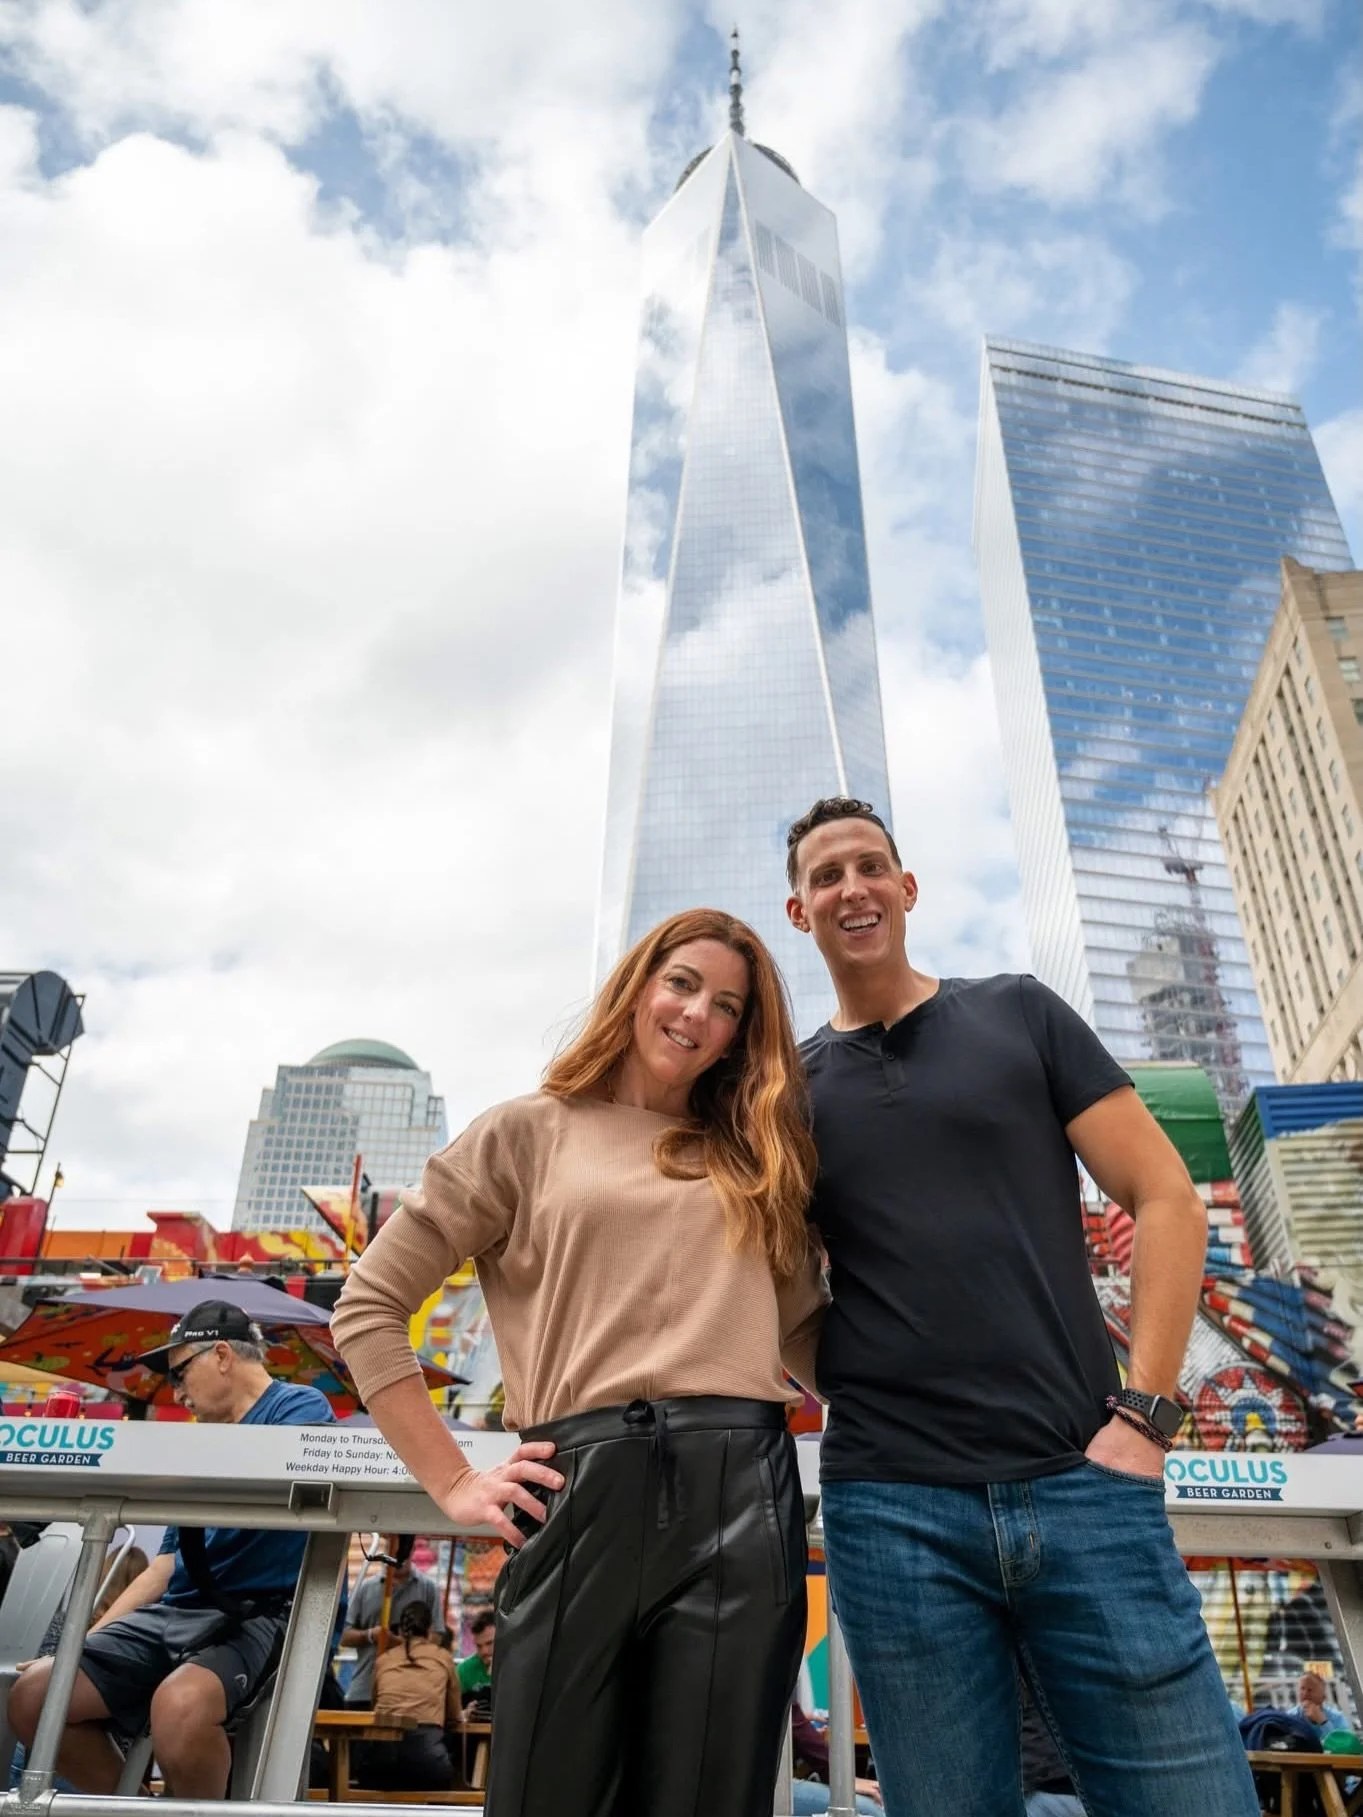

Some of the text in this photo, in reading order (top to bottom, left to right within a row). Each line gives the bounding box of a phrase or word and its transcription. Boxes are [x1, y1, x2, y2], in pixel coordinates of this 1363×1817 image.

[0, 1423, 115, 1451] OCULUS
[300, 1433, 338, 1446] Monday
[340, 1435, 350, 1444] to
[6, 1452, 91, 1465] BEER GARDEN
[303, 1448, 399, 1461] Friday to Sunday: No
[285, 1462, 329, 1474] Weekday
[332, 1463, 362, 1475] Happy
[364, 1465, 390, 1475] Hour:
[1164, 1458, 1288, 1485] OCULUS
[1186, 1487, 1272, 1499] BEER GARDEN
